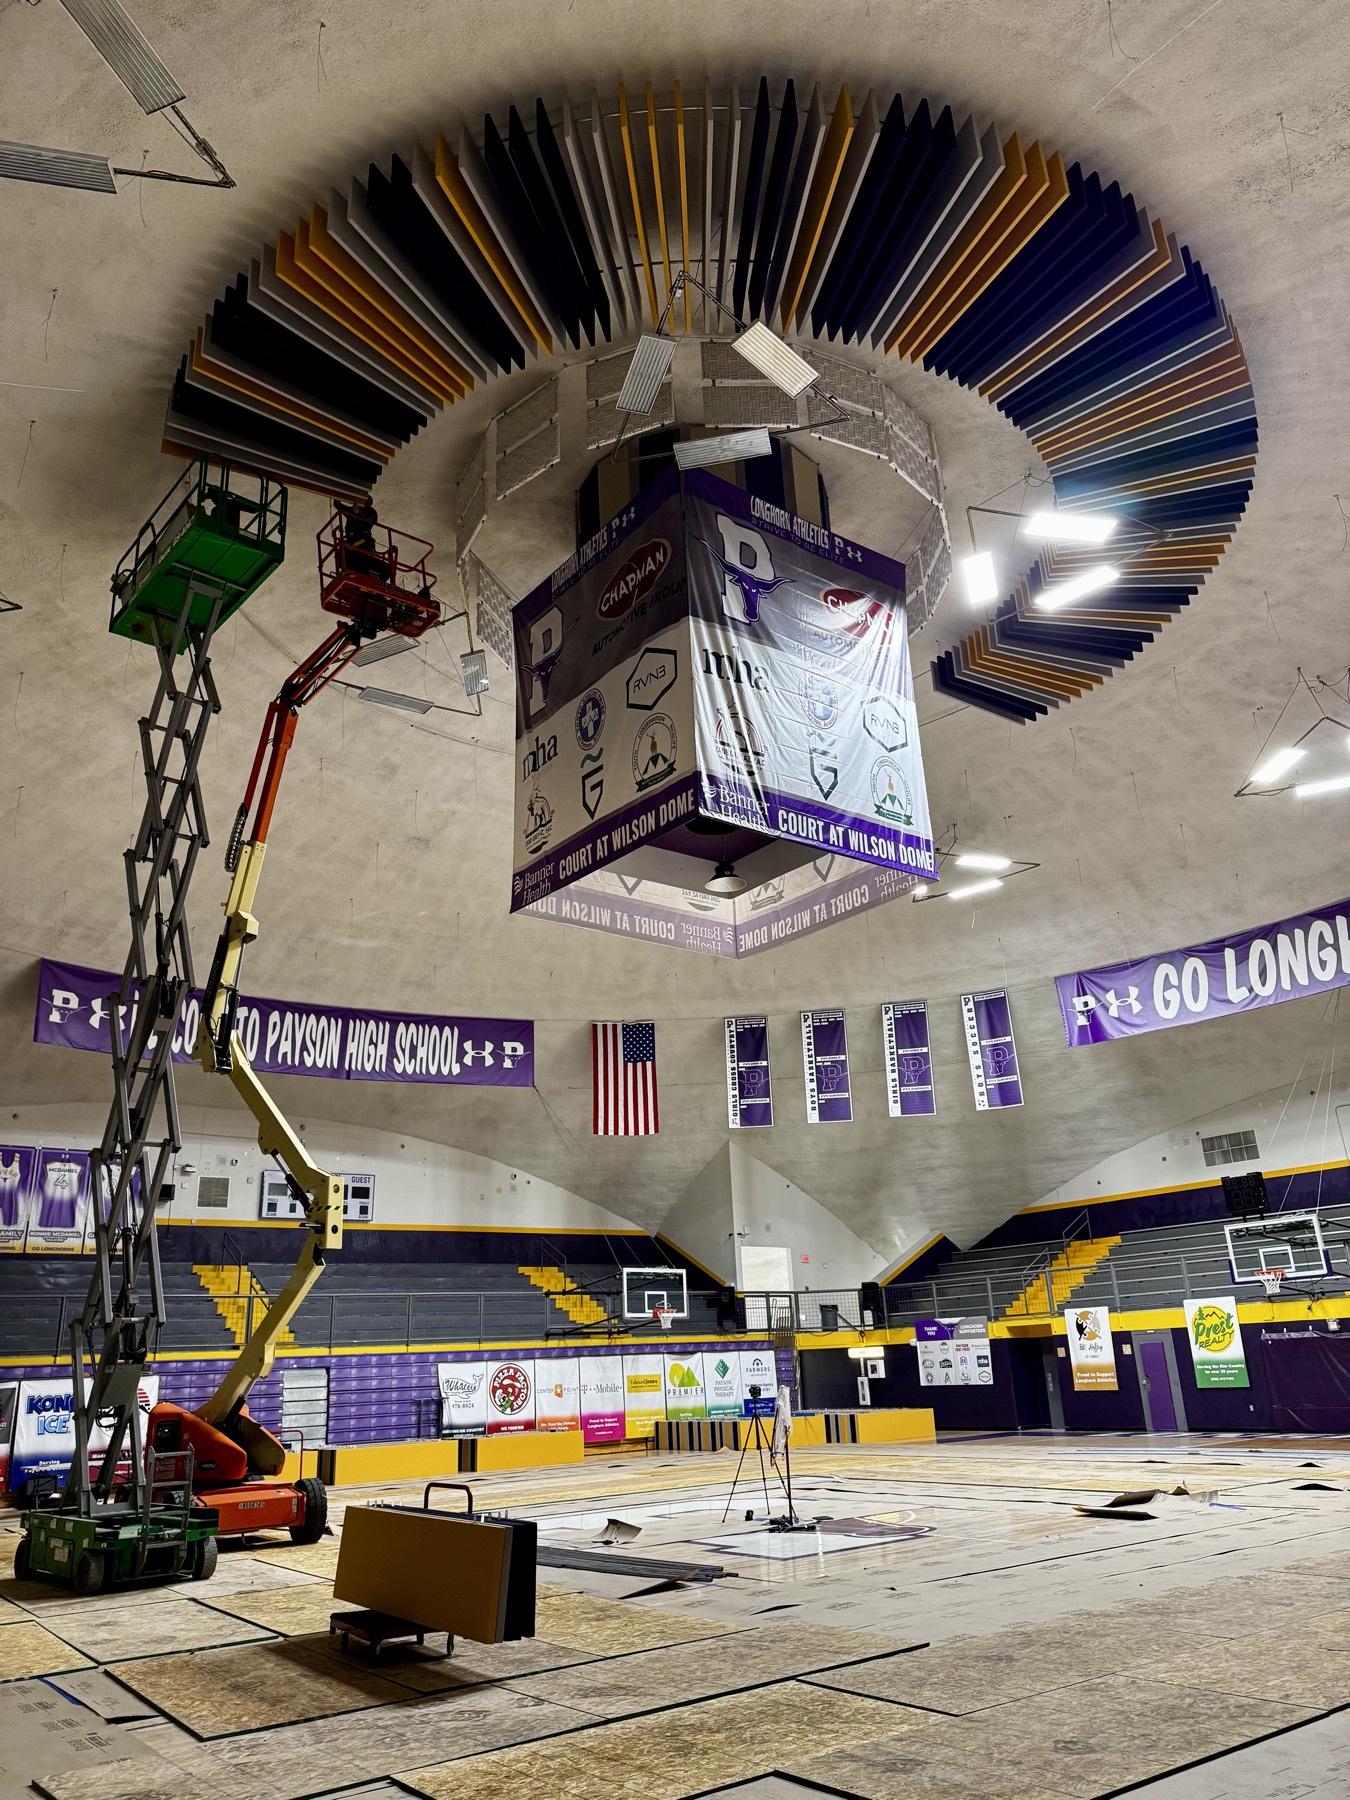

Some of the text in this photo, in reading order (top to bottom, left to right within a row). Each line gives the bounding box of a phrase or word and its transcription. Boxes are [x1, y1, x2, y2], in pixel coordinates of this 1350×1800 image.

[750, 495, 791, 532] LONGHORN
[792, 515, 829, 550] ATHLETICS
[751, 516, 845, 565] STRIVE TO BE ELITE
[601, 546, 665, 613] CHAPMAN
[592, 602, 648, 658] AUTOMOTIVE
[702, 645, 770, 694] mha
[522, 734, 560, 783] mha
[719, 783, 770, 816] Banner
[719, 804, 767, 829] Health
[559, 788, 696, 881] COURT AT WILSON DOME
[778, 809, 934, 873] COURT AT WILSON DOME
[522, 878, 552, 907] Health
[523, 861, 556, 890] Banner
[1153, 957, 1209, 1020] GO
[237, 1006, 260, 1062] TO
[265, 1010, 343, 1070] PAYSON
[345, 1018, 389, 1074] HIGH
[393, 1021, 461, 1077] SCHOOL
[728, 1029, 736, 1064] COUNTRY
[805, 1023, 815, 1084] BASKETBALL
[887, 1015, 899, 1105] GIRLS BASKETBALL
[966, 1007, 986, 1097] BOYS SOCCER
[730, 1066, 738, 1092] CROSS
[53, 1173, 70, 1190] 4
[351, 1175, 371, 1184] GUEST
[0, 1230, 24, 1238] AMILY
[1194, 1312, 1234, 1346] Prest
[1198, 1329, 1235, 1351] REALTY
[27, 1393, 74, 1415] KON
[494, 1368, 528, 1410] PIZZA FACTORY
[667, 1387, 705, 1397] PREMIER
[37, 1414, 70, 1436] ICE
